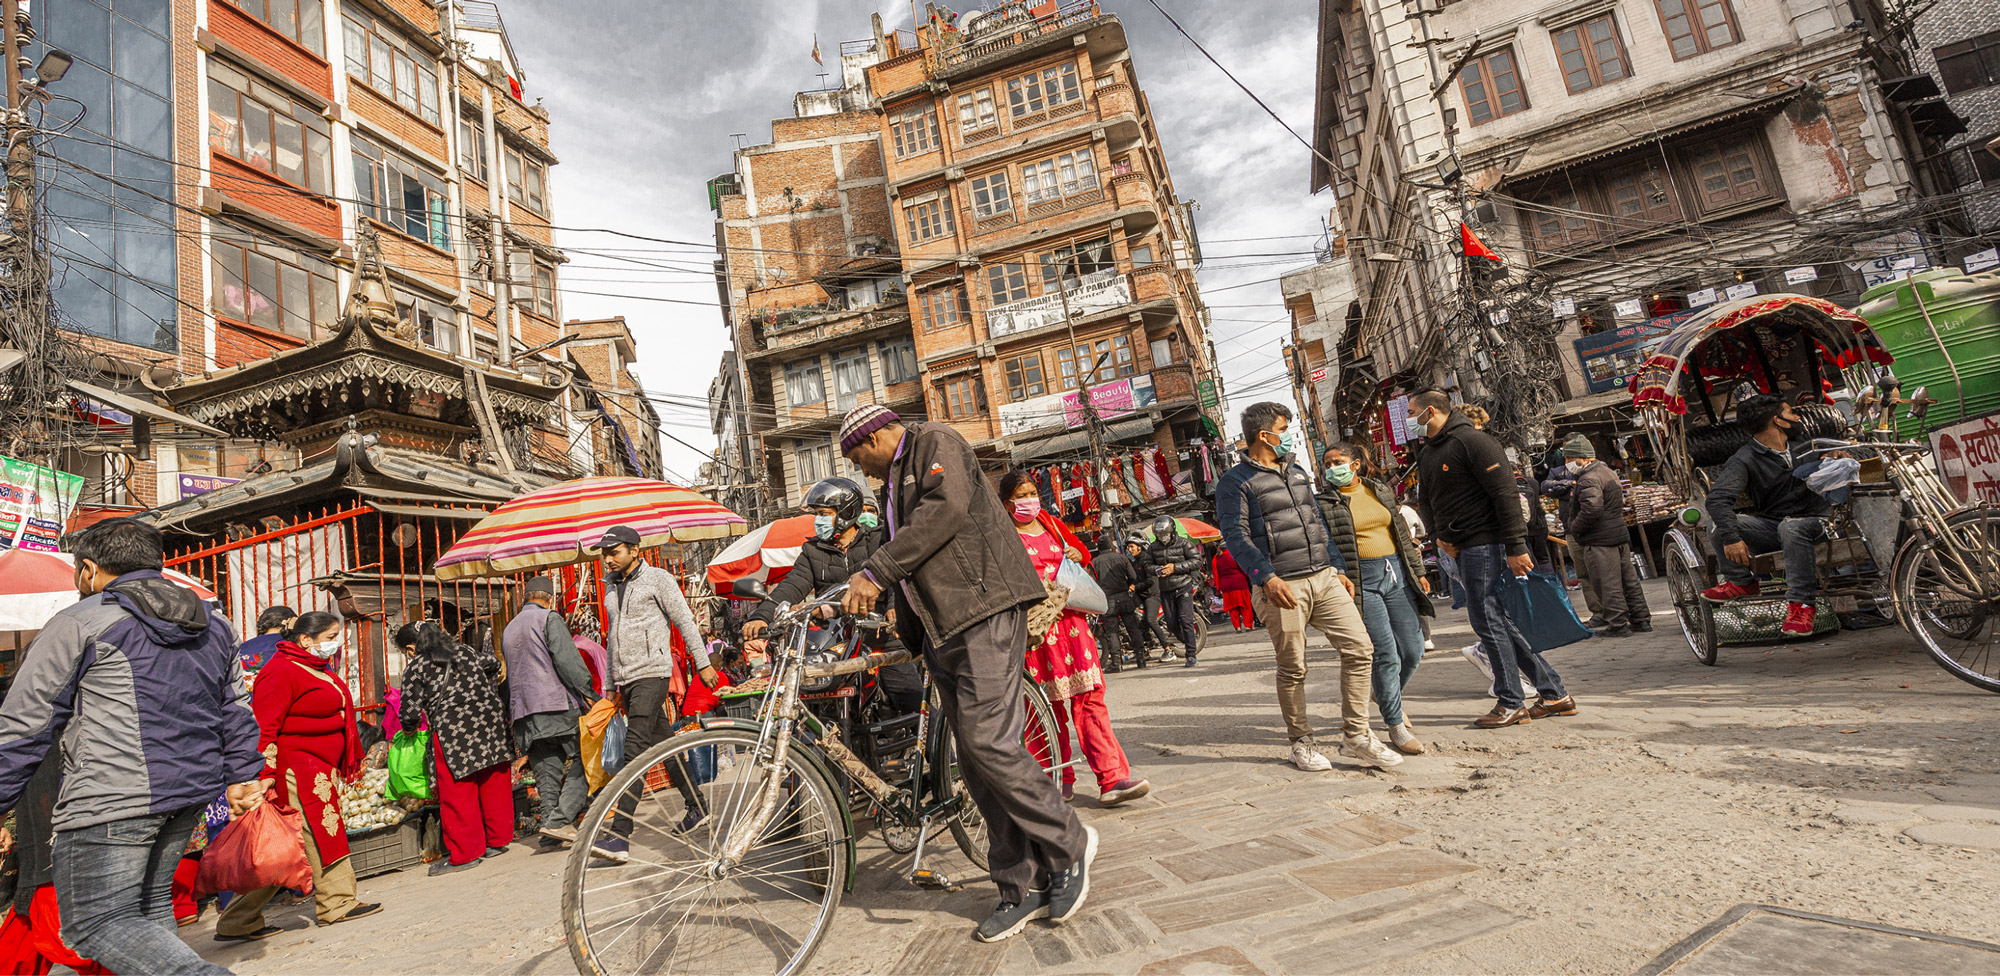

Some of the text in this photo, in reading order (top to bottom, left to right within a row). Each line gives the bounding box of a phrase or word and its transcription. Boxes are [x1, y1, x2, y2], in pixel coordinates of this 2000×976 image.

[988, 276, 1125, 318] NEW CHANDANI BEAUTY PARLOUR
[1073, 290, 1106, 302] Center
[1093, 385, 1129, 400] Beauty
[27, 542, 53, 552] Law
